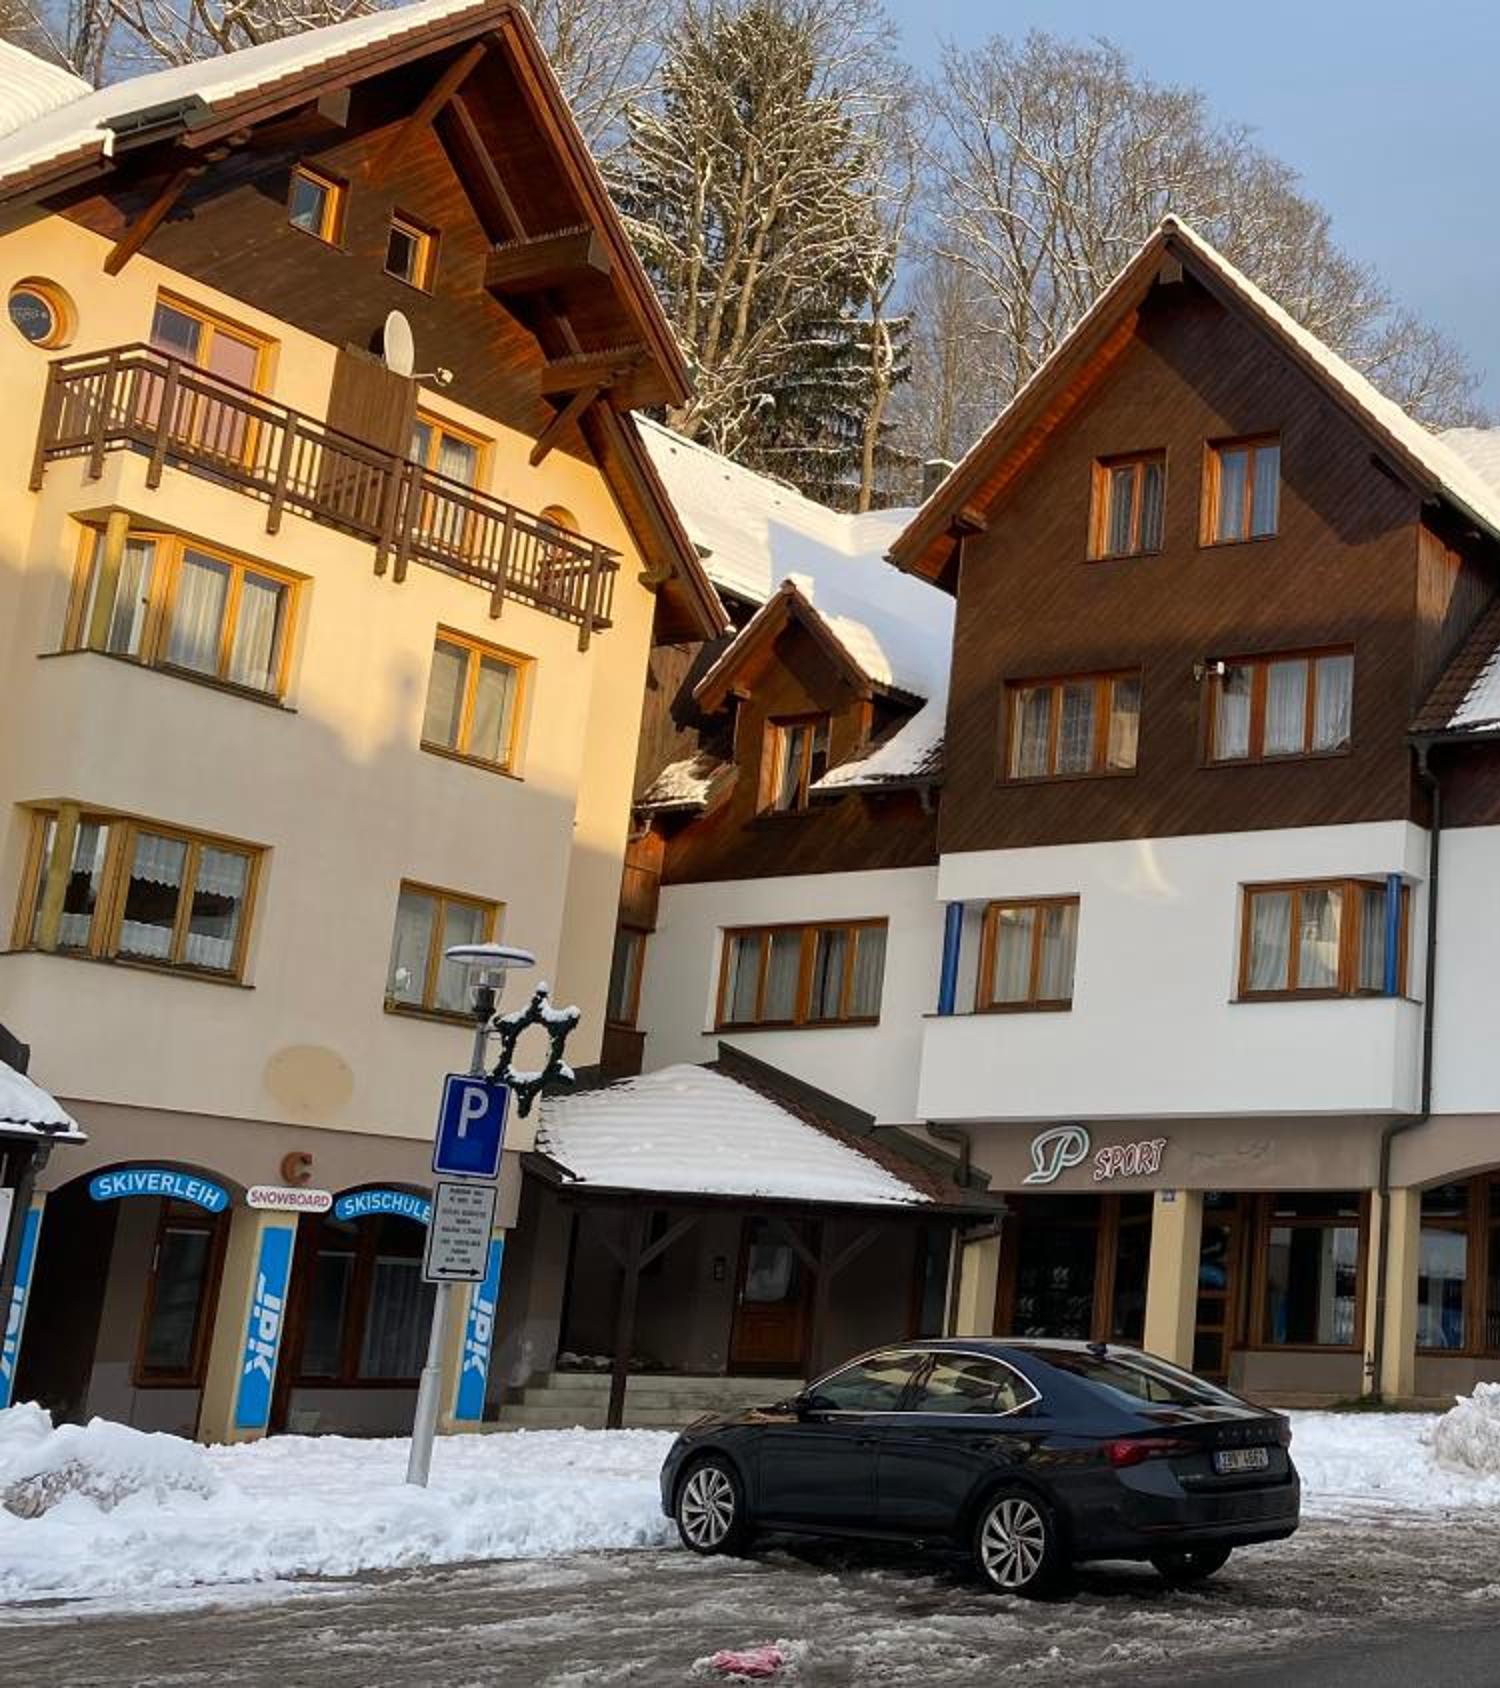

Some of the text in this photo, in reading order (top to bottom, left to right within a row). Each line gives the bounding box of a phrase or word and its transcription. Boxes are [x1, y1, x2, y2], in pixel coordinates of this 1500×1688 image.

[458, 1086, 489, 1138] P
[281, 1151, 313, 1184] C
[1094, 1138, 1167, 1181] SPORT
[99, 1173, 220, 1207] SKIVERLEIH
[250, 1190, 331, 1208] SNOWBOARD
[345, 1193, 431, 1223] SKISCHULE
